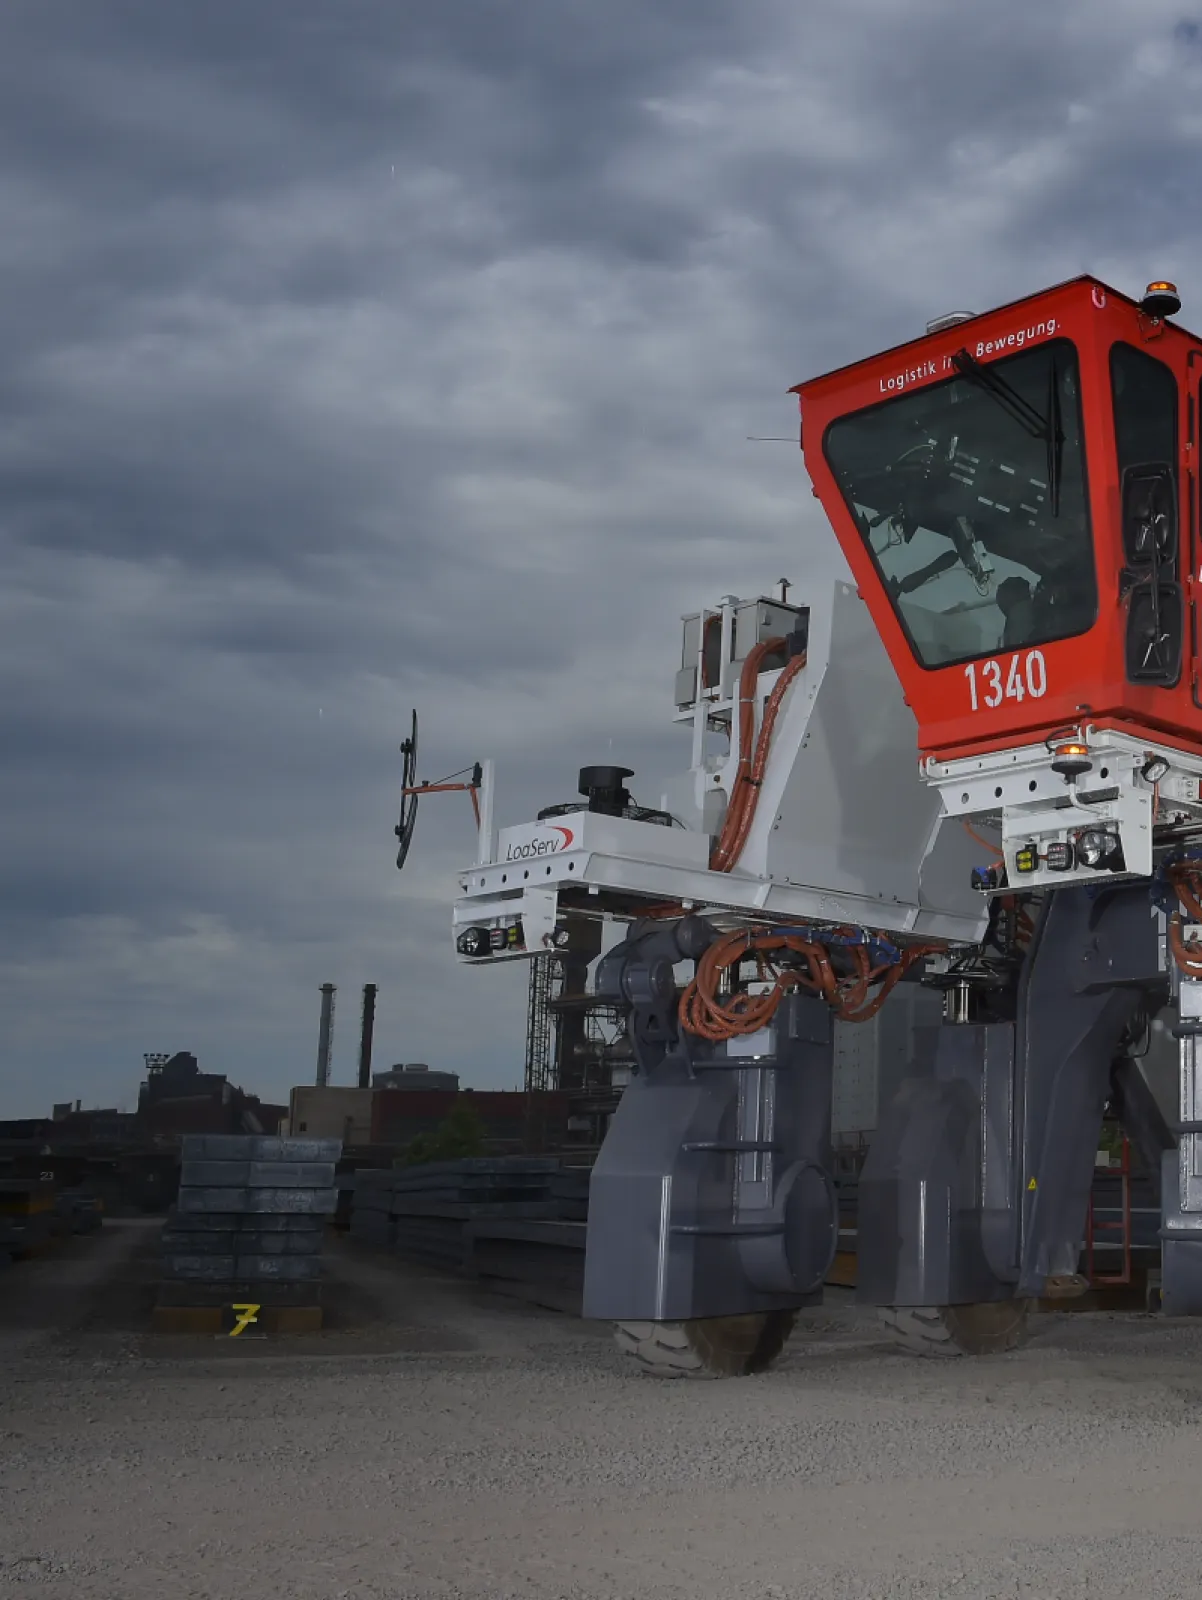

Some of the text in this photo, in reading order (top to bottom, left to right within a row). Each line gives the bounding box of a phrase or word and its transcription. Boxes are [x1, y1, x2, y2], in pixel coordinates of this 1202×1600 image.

[879, 361, 936, 392] Logistik
[975, 318, 1061, 357] Bewegung.
[964, 649, 1047, 711] 1340
[229, 1303, 261, 1337] 7
